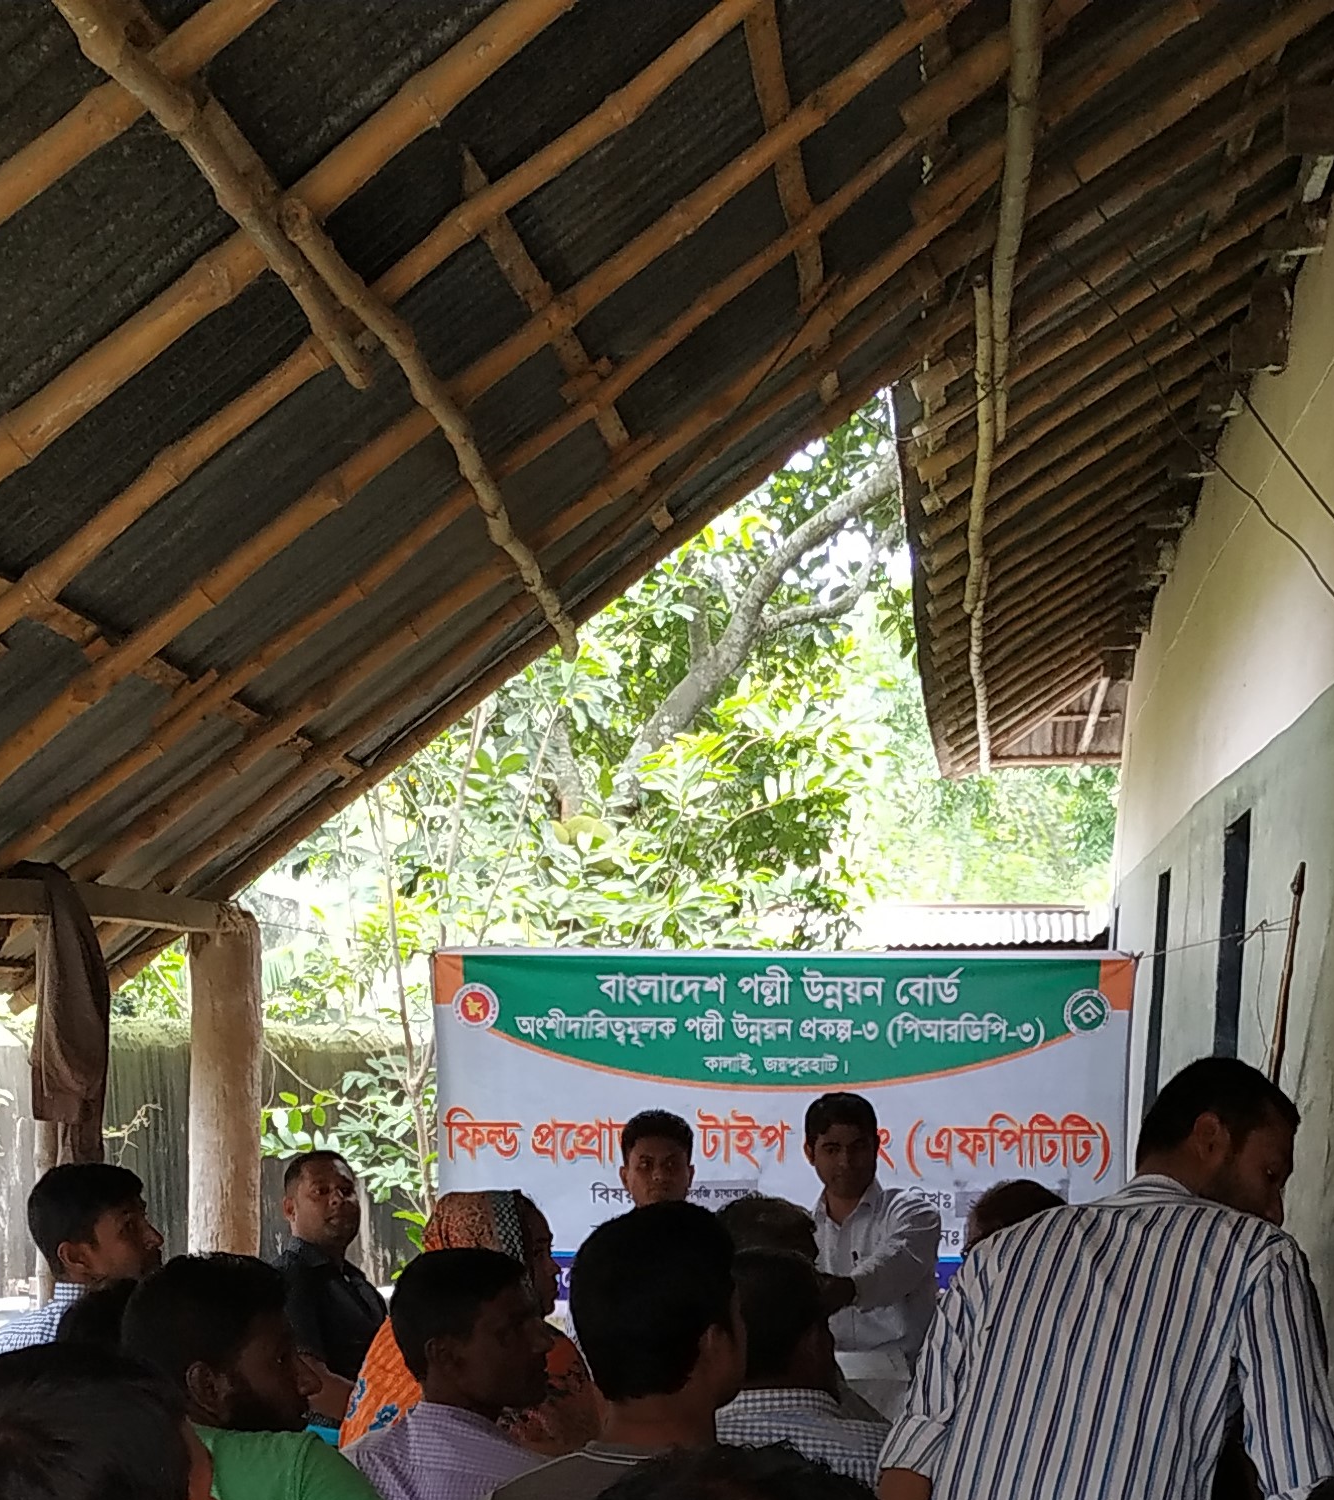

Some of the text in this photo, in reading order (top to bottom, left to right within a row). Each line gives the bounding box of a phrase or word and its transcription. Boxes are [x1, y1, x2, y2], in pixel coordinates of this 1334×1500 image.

[596, 965, 966, 1012] বাংলাদেশ পল্লী উন্নয়ন বোর্ড
[684, 1008, 725, 1043] পল্লী
[443, 1106, 524, 1164] ফিল্ড
[696, 1107, 792, 1169] টাইপ
